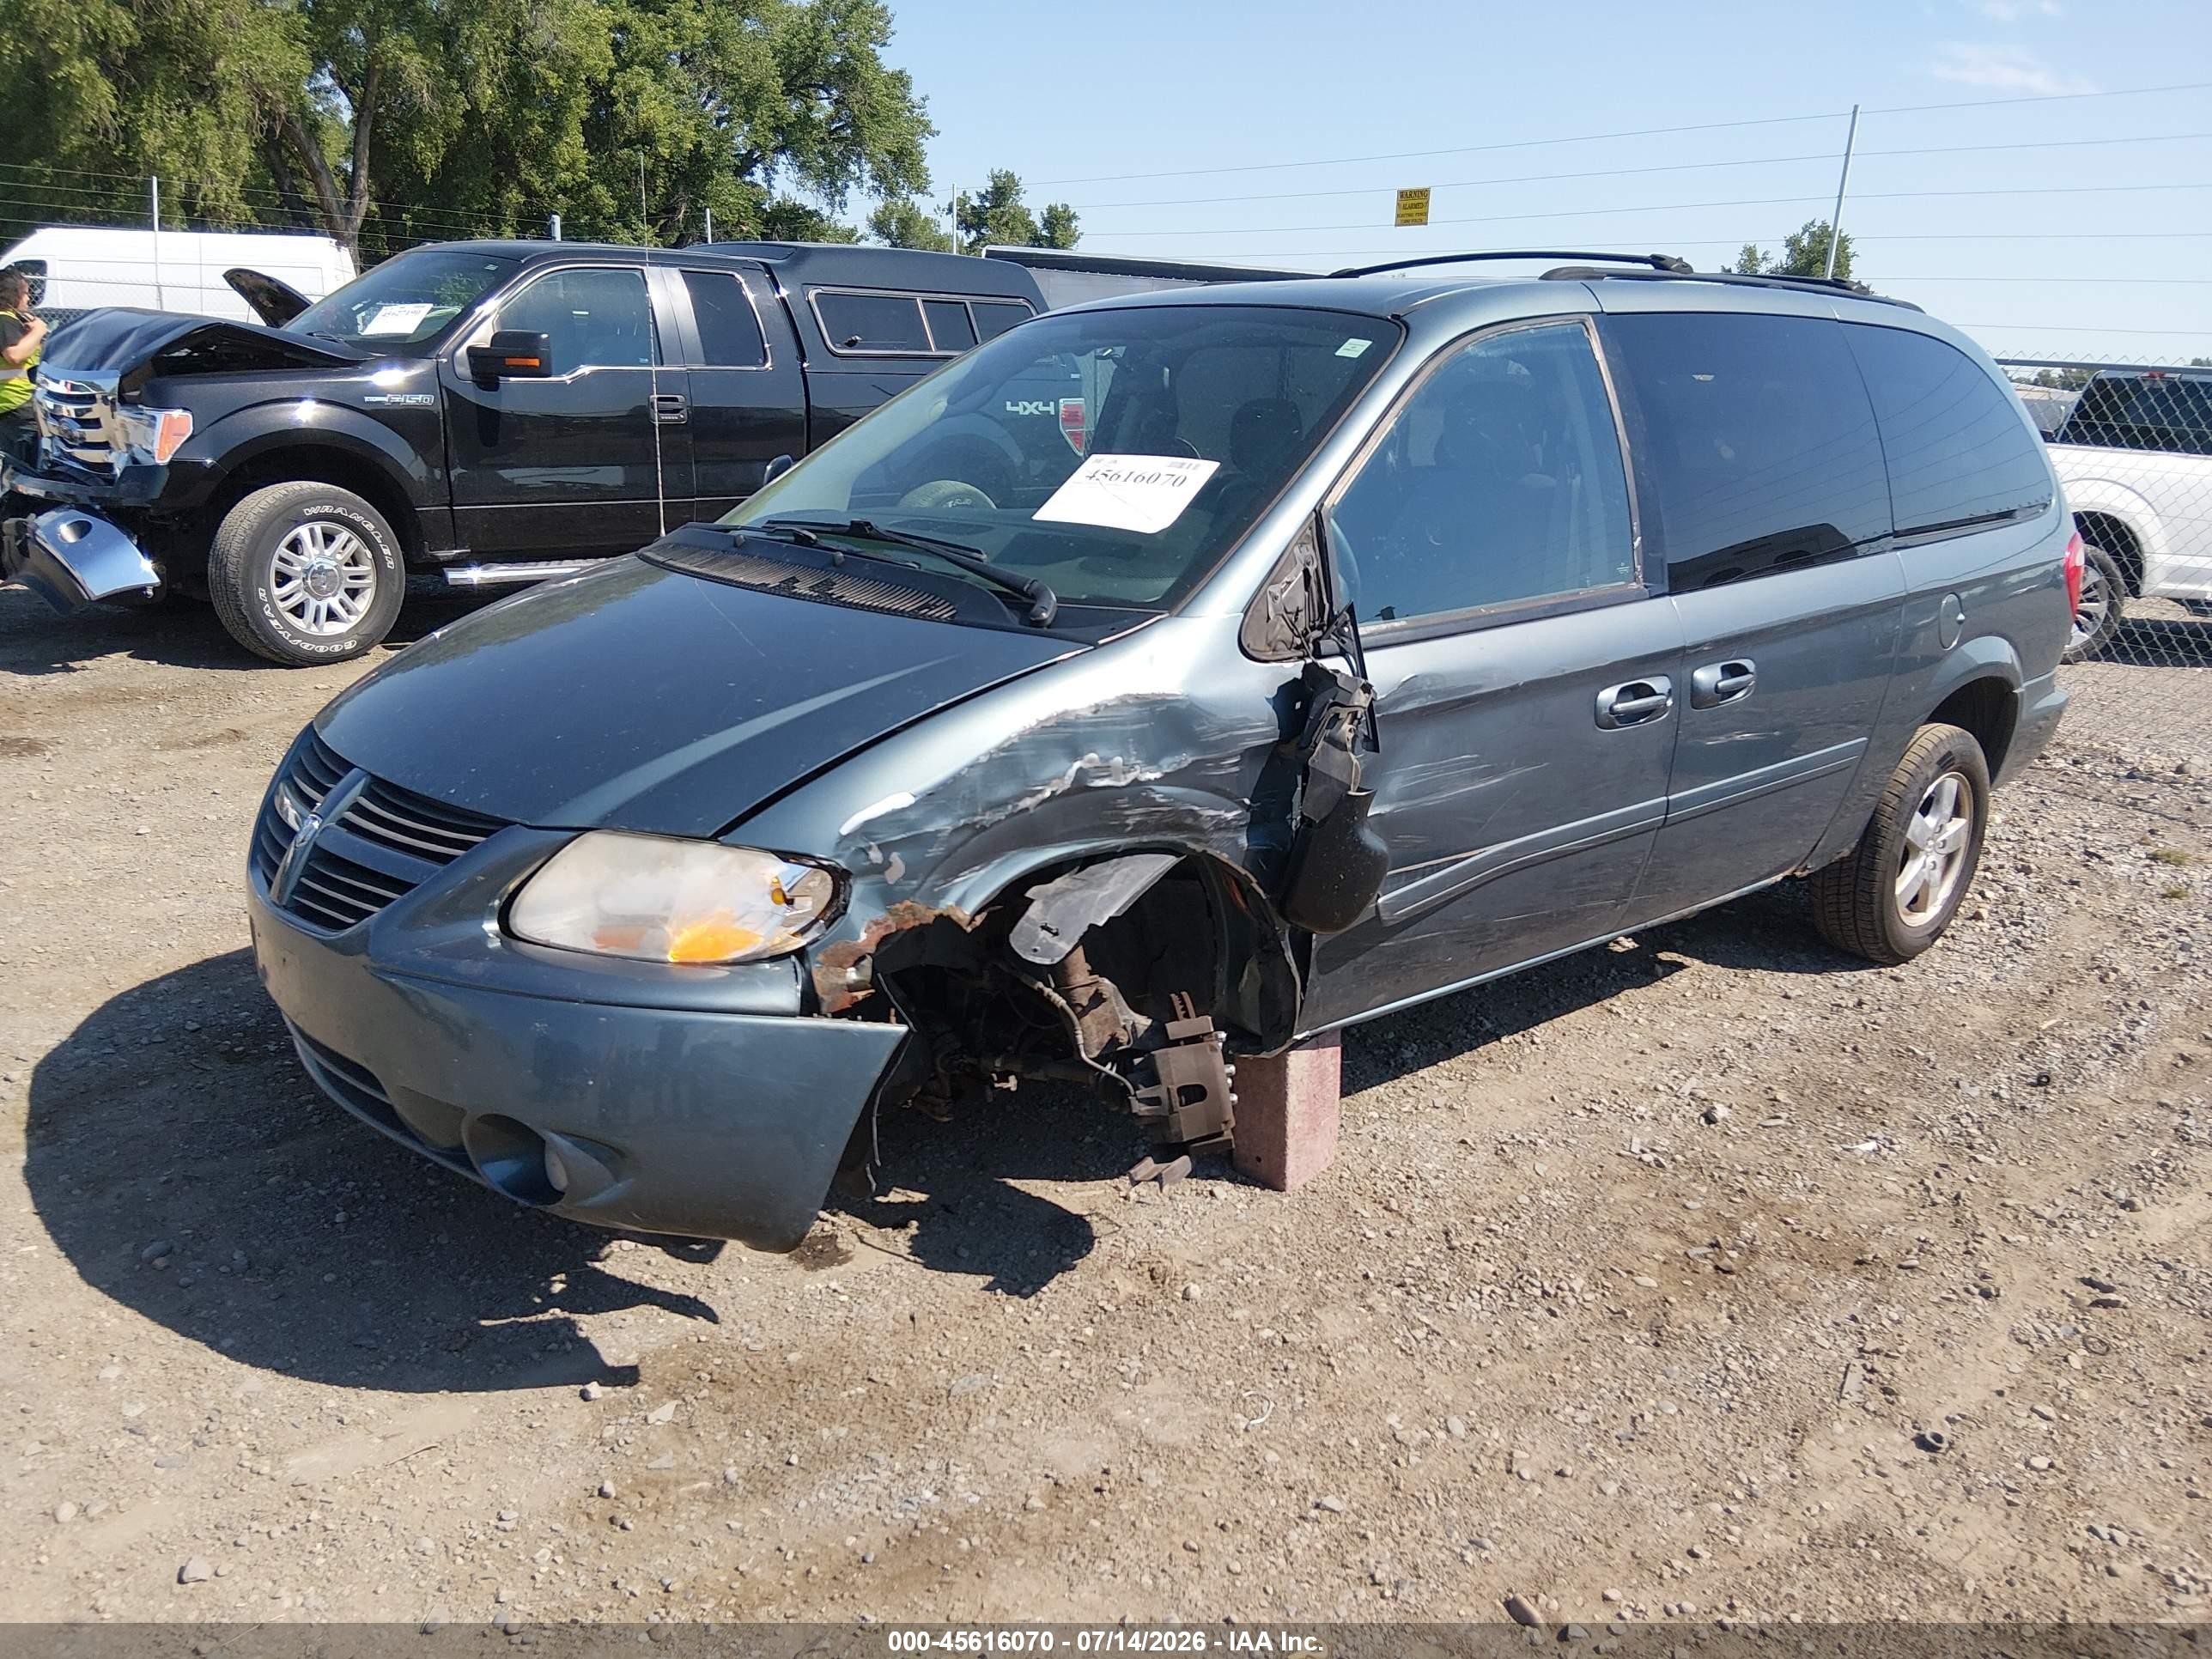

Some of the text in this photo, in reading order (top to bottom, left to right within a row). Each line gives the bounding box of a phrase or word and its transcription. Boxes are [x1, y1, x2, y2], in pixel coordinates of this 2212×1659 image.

[1400, 190, 1428, 198] WARNING
[1085, 468, 1188, 488] 45616070
[303, 505, 395, 569] WRANGLER
[258, 586, 358, 653] GOODYEAR
